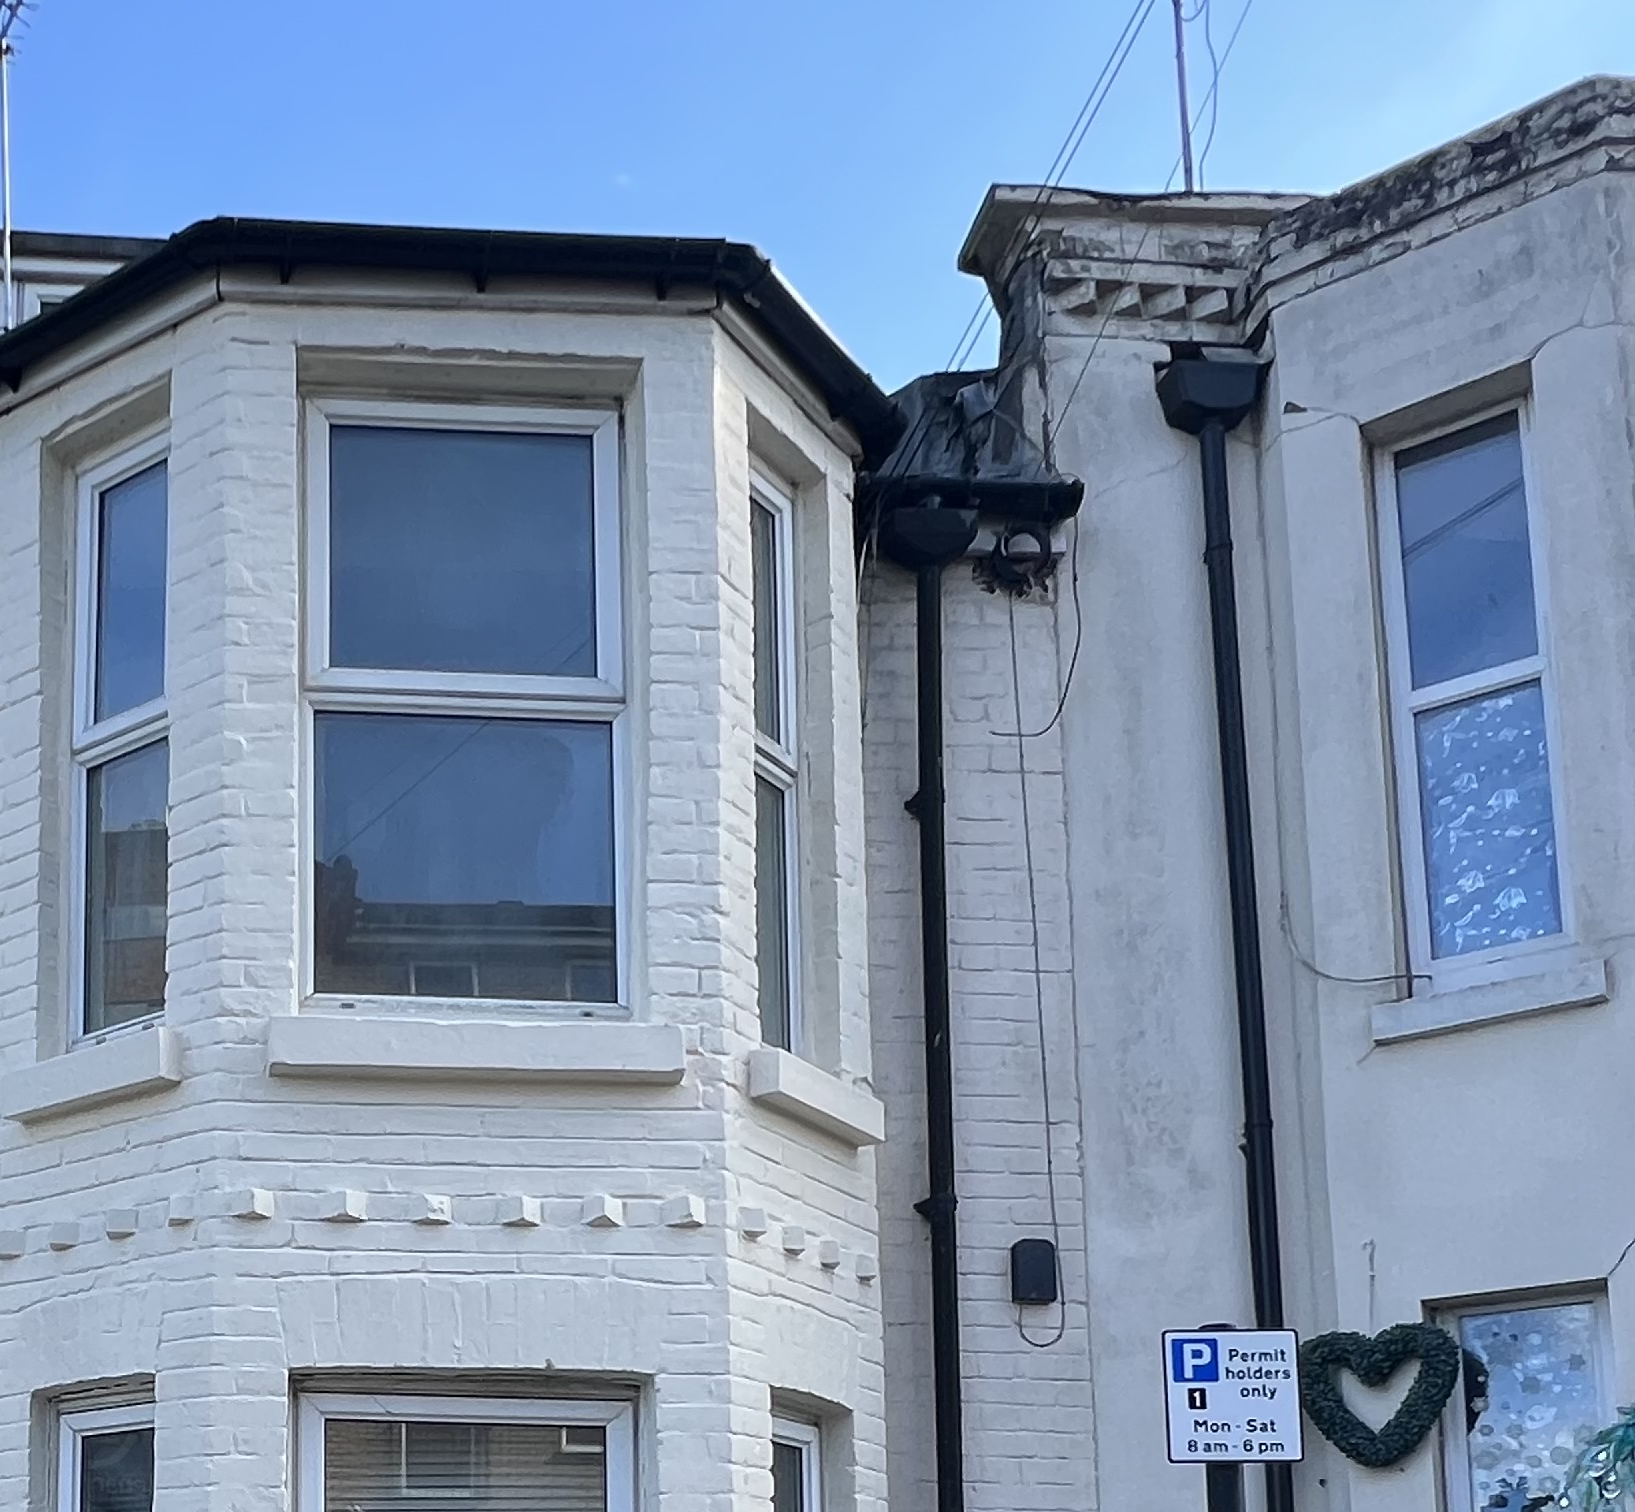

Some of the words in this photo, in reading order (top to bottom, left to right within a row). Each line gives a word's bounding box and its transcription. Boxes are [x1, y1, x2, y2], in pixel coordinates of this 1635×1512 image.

[1183, 1343, 1212, 1379] P
[1228, 1348, 1287, 1363] Permit
[1225, 1366, 1291, 1380] holders
[1193, 1391, 1201, 1407] 1
[1239, 1384, 1277, 1400] only
[1193, 1419, 1232, 1433] Mon
[1246, 1418, 1277, 1433] Sat
